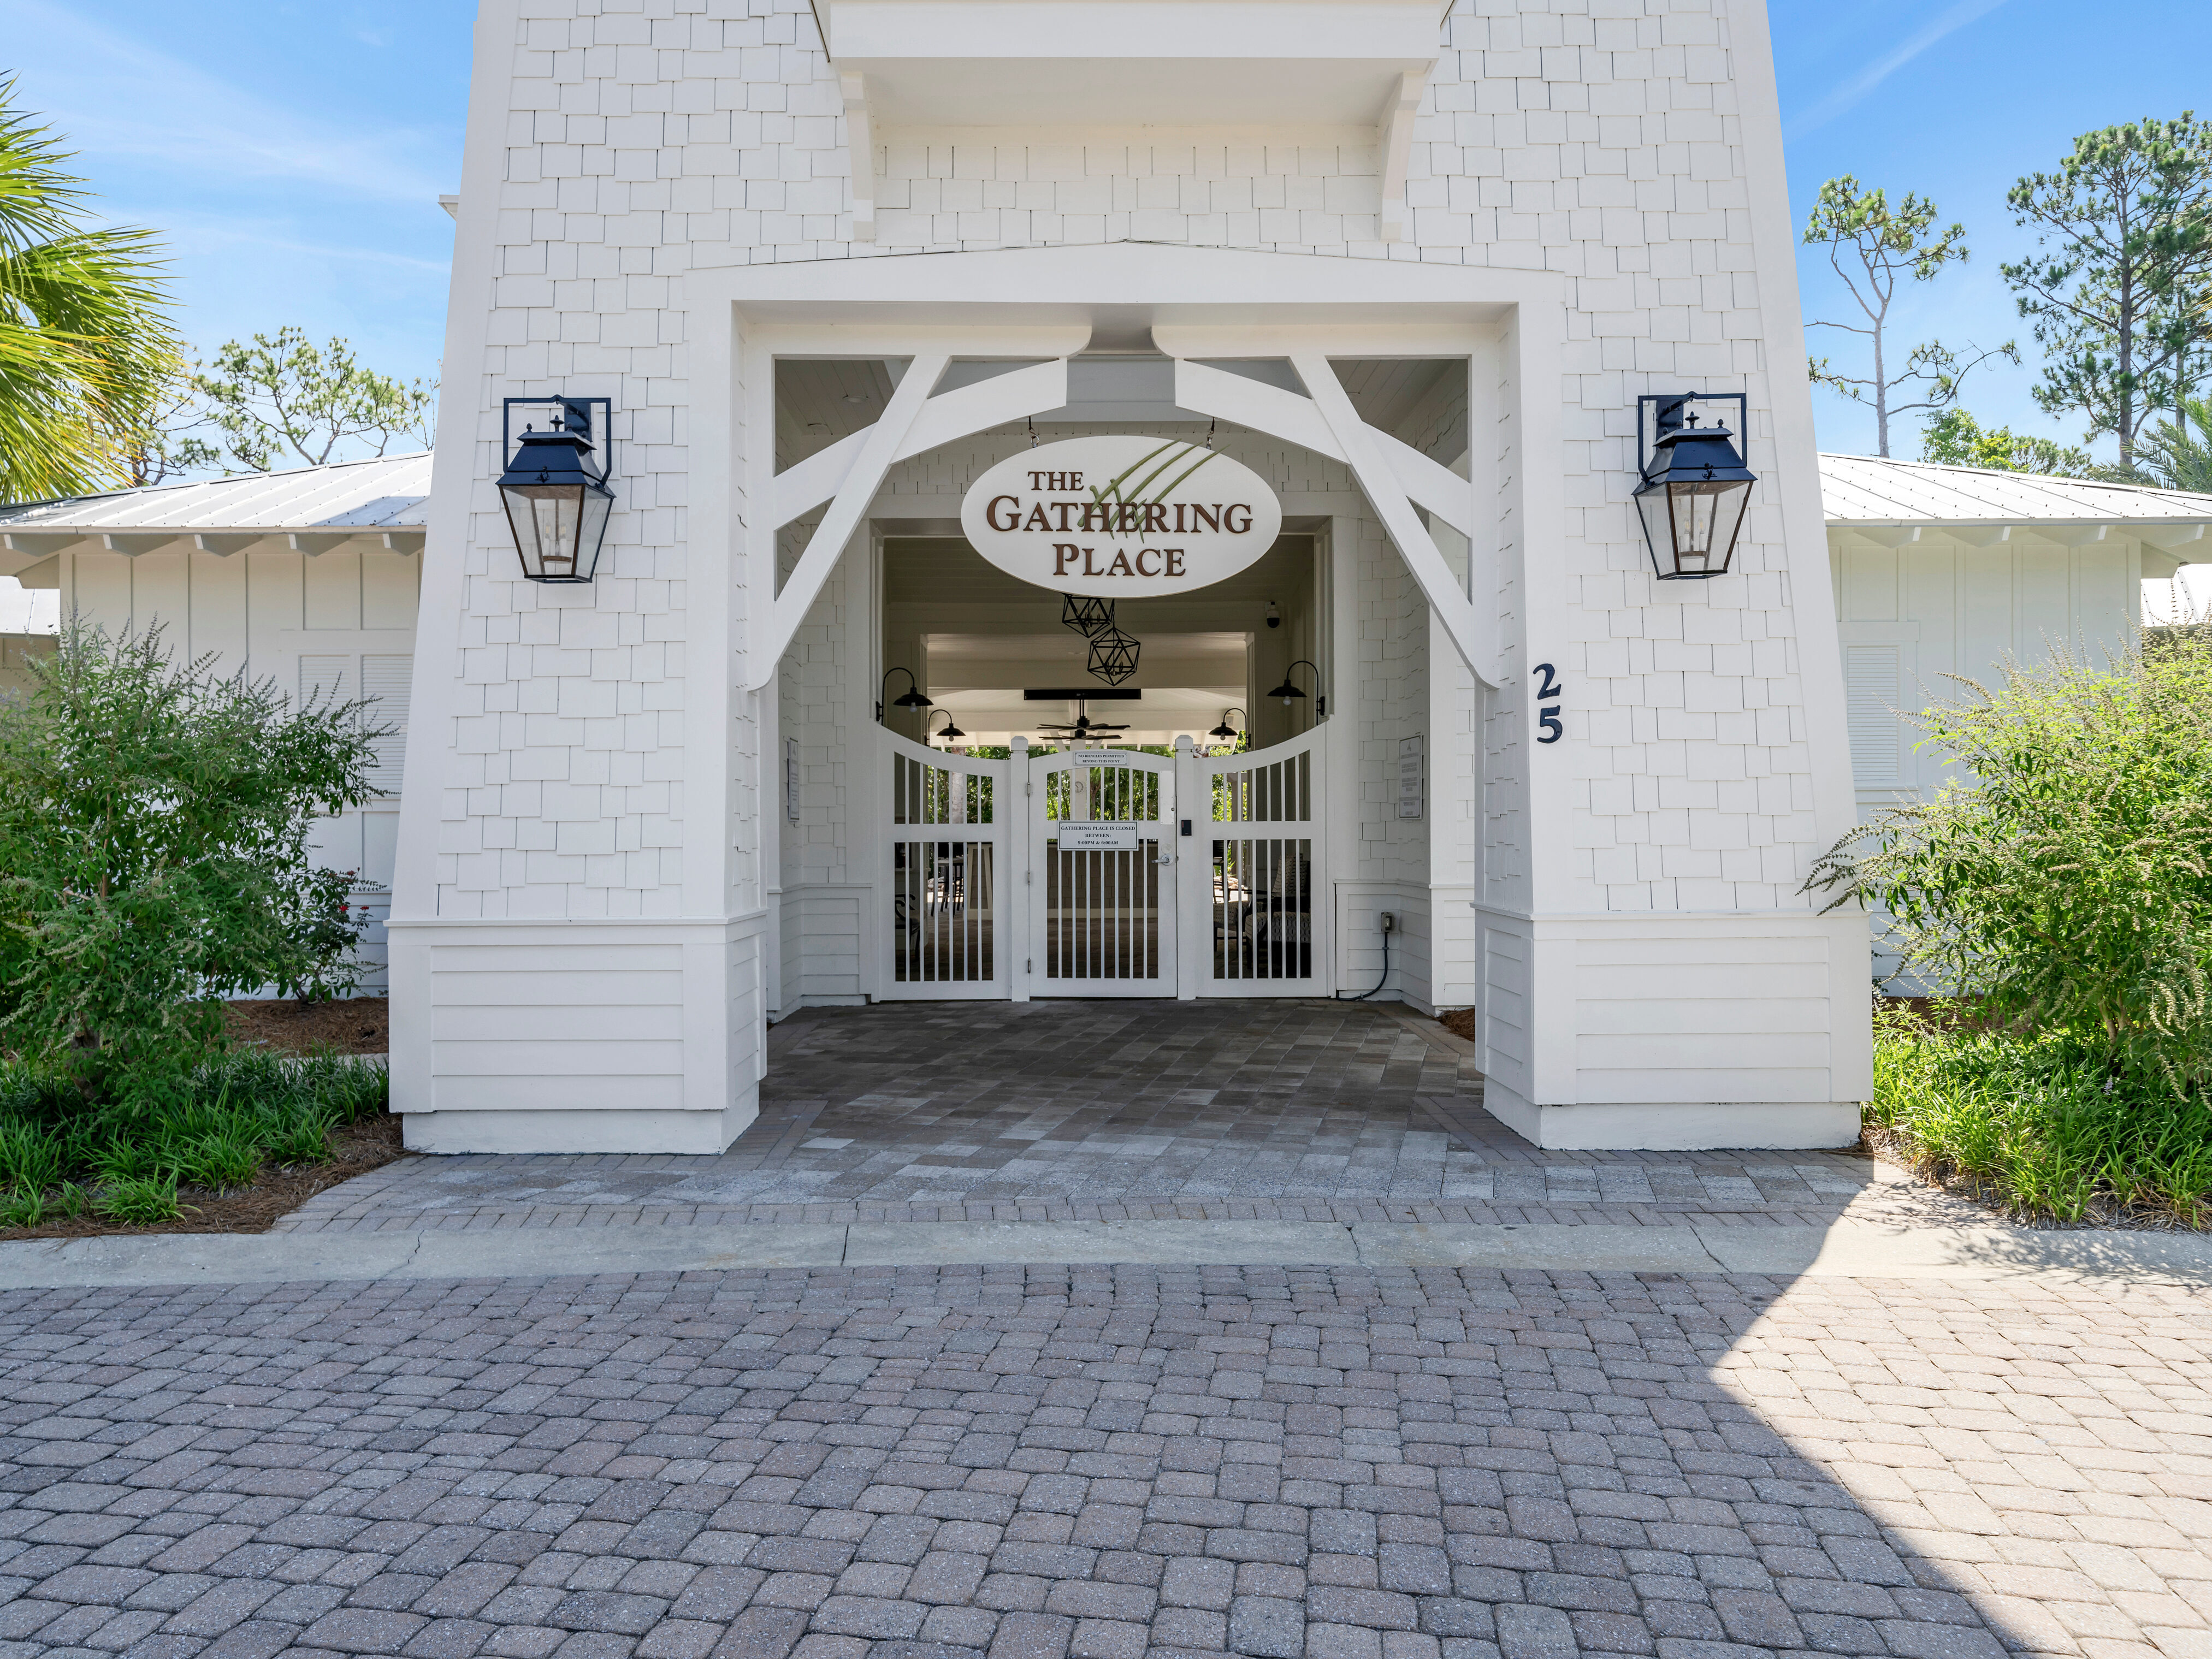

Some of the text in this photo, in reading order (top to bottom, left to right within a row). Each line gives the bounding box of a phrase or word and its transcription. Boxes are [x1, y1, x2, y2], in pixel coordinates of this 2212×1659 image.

[1027, 471, 1084, 491] THE
[986, 495, 1253, 534] GATHERING
[1052, 543, 1186, 577] PLACE
